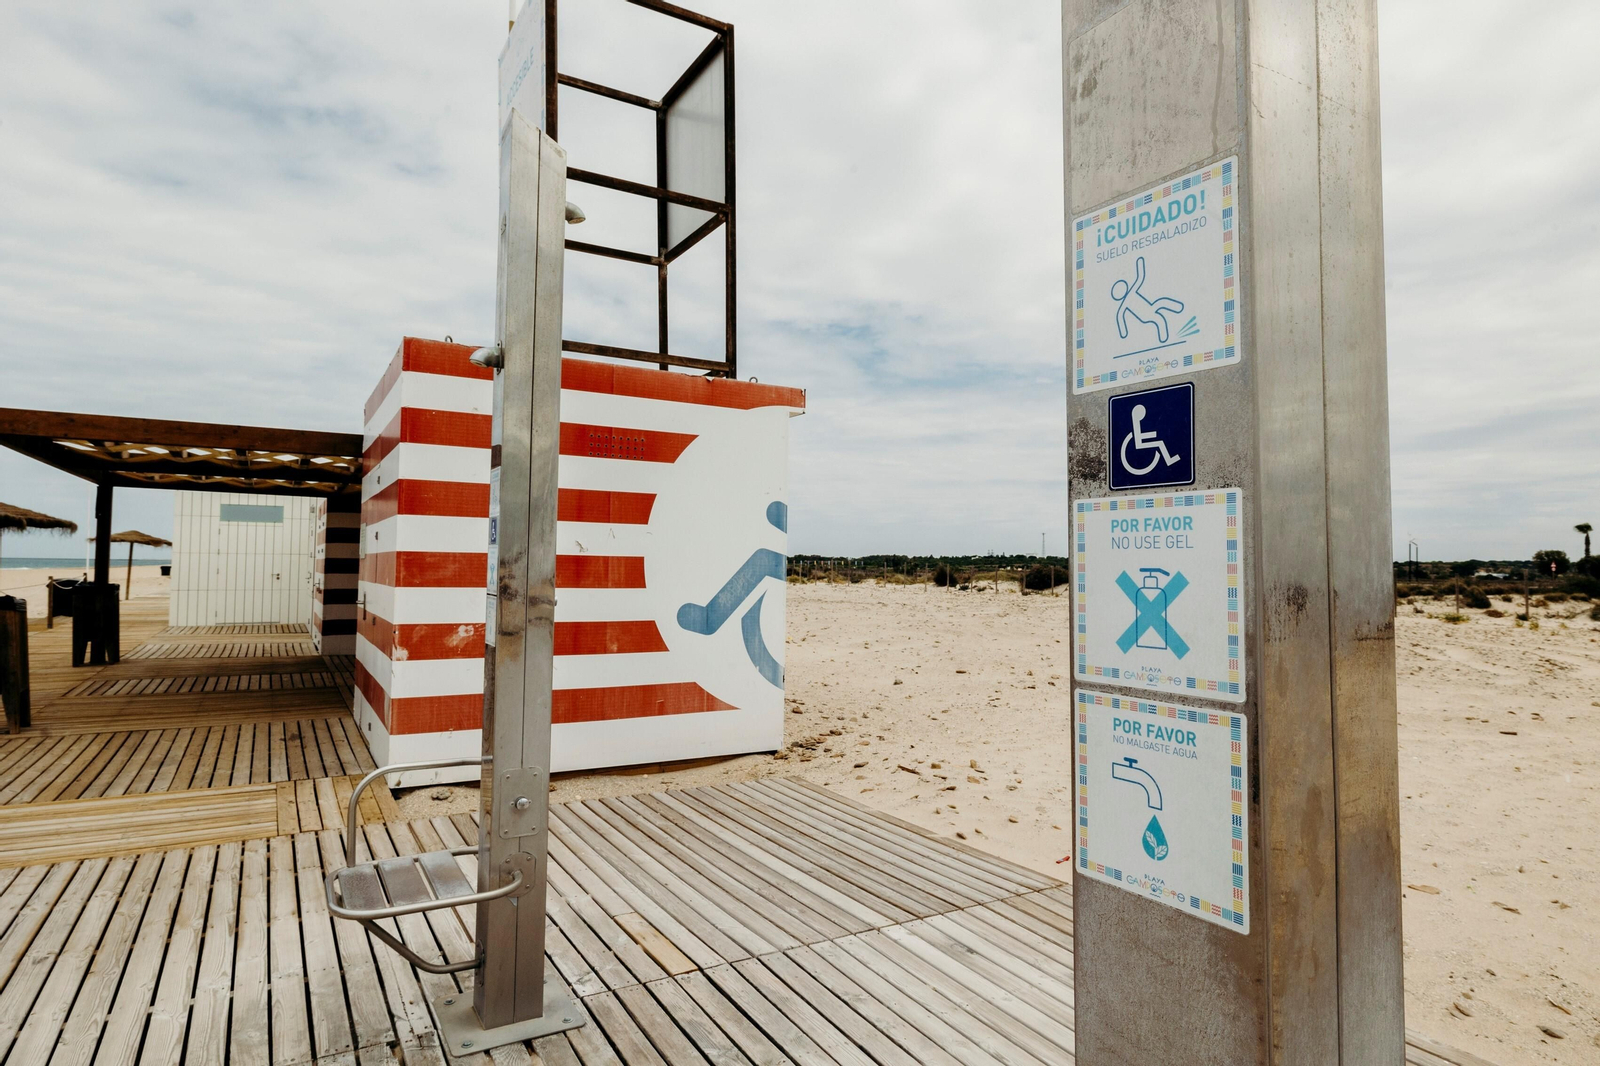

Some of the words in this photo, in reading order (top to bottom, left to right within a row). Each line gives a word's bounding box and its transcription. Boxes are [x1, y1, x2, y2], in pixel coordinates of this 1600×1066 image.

[1096, 189, 1206, 247] ¡CUIDADO!
[1096, 243, 1129, 264] SUELO
[1131, 215, 1207, 252] RESBALADIZO
[1139, 356, 1160, 366] PLAYA
[1111, 518, 1140, 533] POR
[1144, 515, 1193, 532] FAVOR
[1111, 535, 1130, 549] NO
[1134, 535, 1161, 549] USE
[1165, 535, 1194, 549] GEL
[1141, 665, 1162, 674] PLAYA
[1112, 717, 1142, 736] POR
[1146, 723, 1197, 747] FAVOR
[1112, 735, 1125, 745] NO
[1126, 737, 1170, 755] MALGASTE
[1172, 747, 1198, 760] AGUA
[1144, 873, 1166, 886] PLAYA
